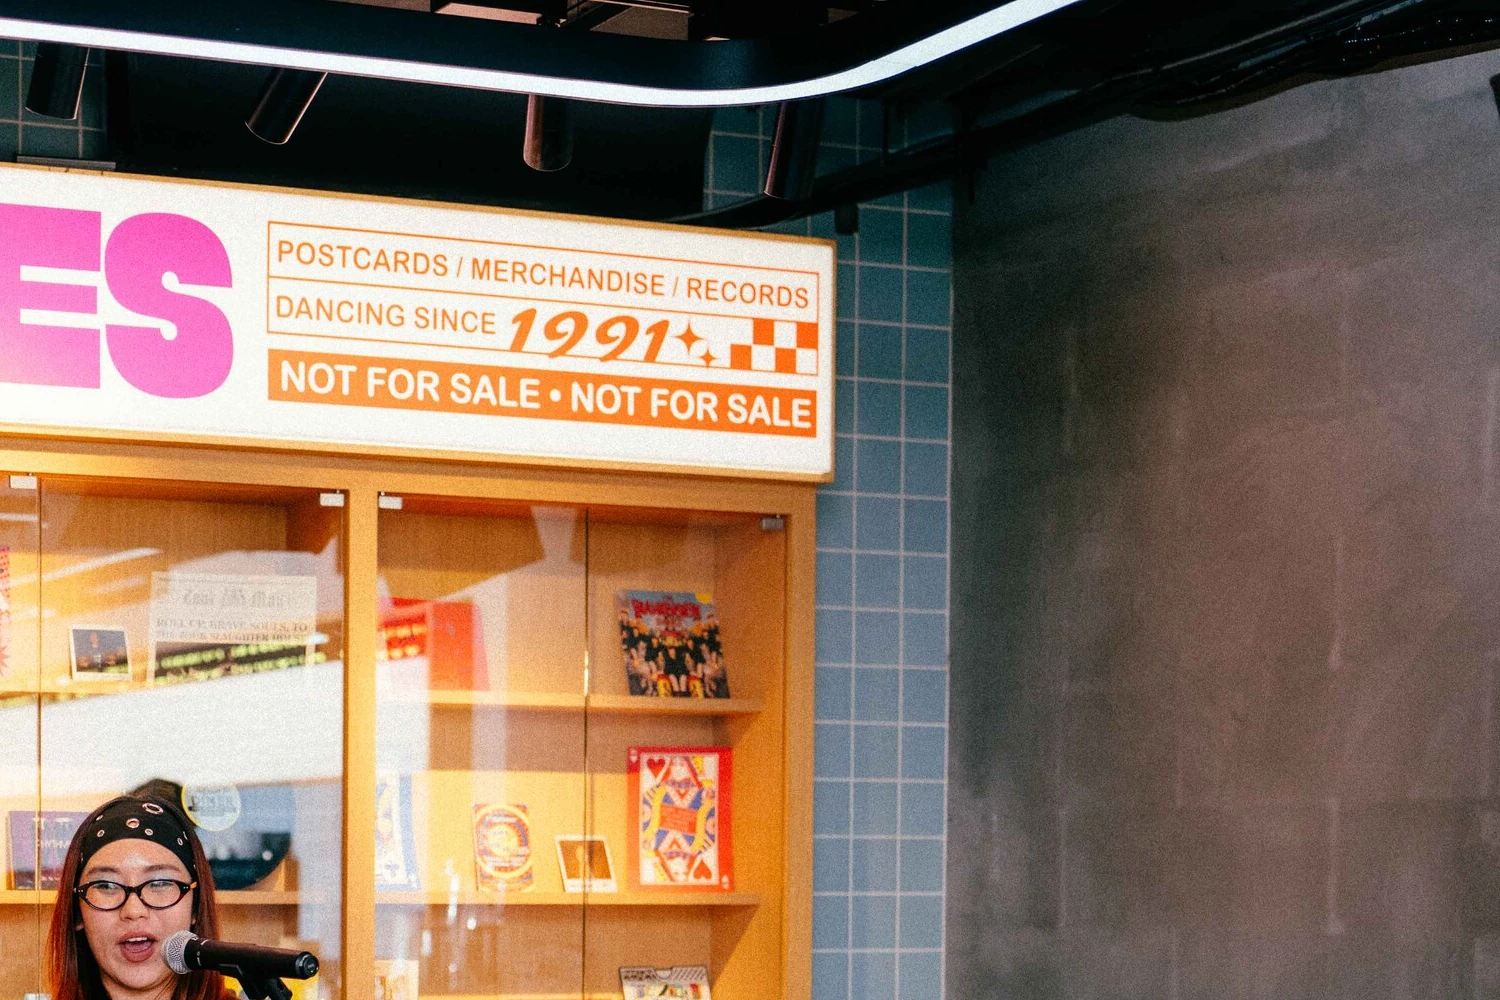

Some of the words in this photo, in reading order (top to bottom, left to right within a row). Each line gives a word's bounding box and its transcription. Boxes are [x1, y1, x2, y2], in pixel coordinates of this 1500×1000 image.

[277, 241, 447, 277] POSTCARDS
[471, 256, 665, 296] MERCHANDISE
[686, 277, 809, 309] RECORDS
[276, 295, 405, 328] DANCING
[414, 307, 496, 335] SINCE
[508, 307, 672, 363] 1991
[280, 360, 357, 394] NOT
[367, 365, 440, 402] FOR
[450, 373, 540, 410] SALE
[571, 382, 641, 416] NOT
[651, 387, 719, 422] FOR
[727, 394, 812, 429] SALE
